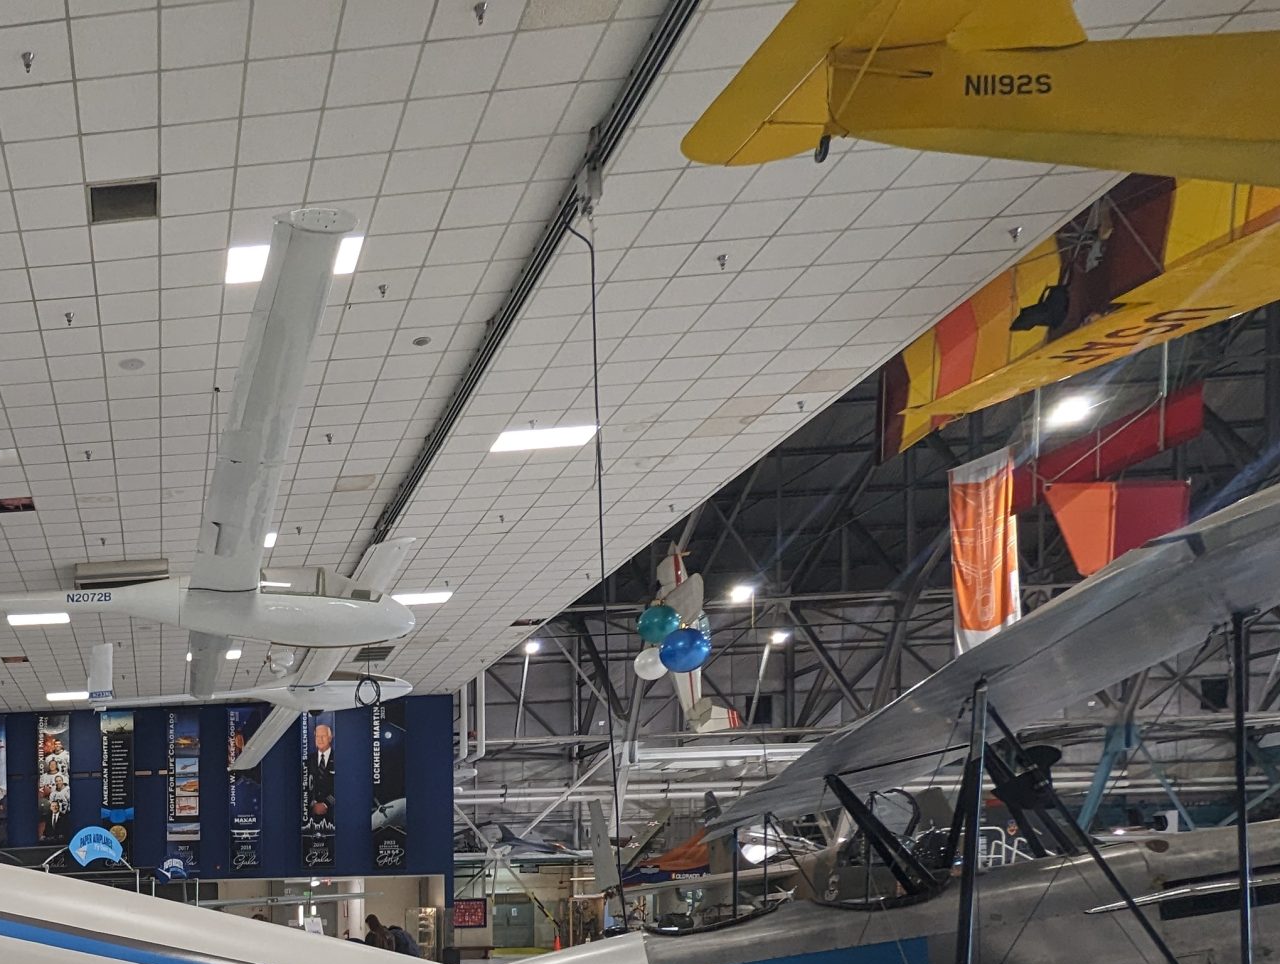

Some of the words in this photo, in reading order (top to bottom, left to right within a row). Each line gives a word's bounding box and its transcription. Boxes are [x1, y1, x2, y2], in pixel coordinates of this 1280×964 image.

[964, 74, 1052, 96] N1192S
[66, 592, 112, 603] N2072B
[373, 741, 381, 785] LOCKHEED
[80, 833, 92, 848] PAPER
[233, 854, 260, 869] Gala
[306, 852, 333, 867] Gala
